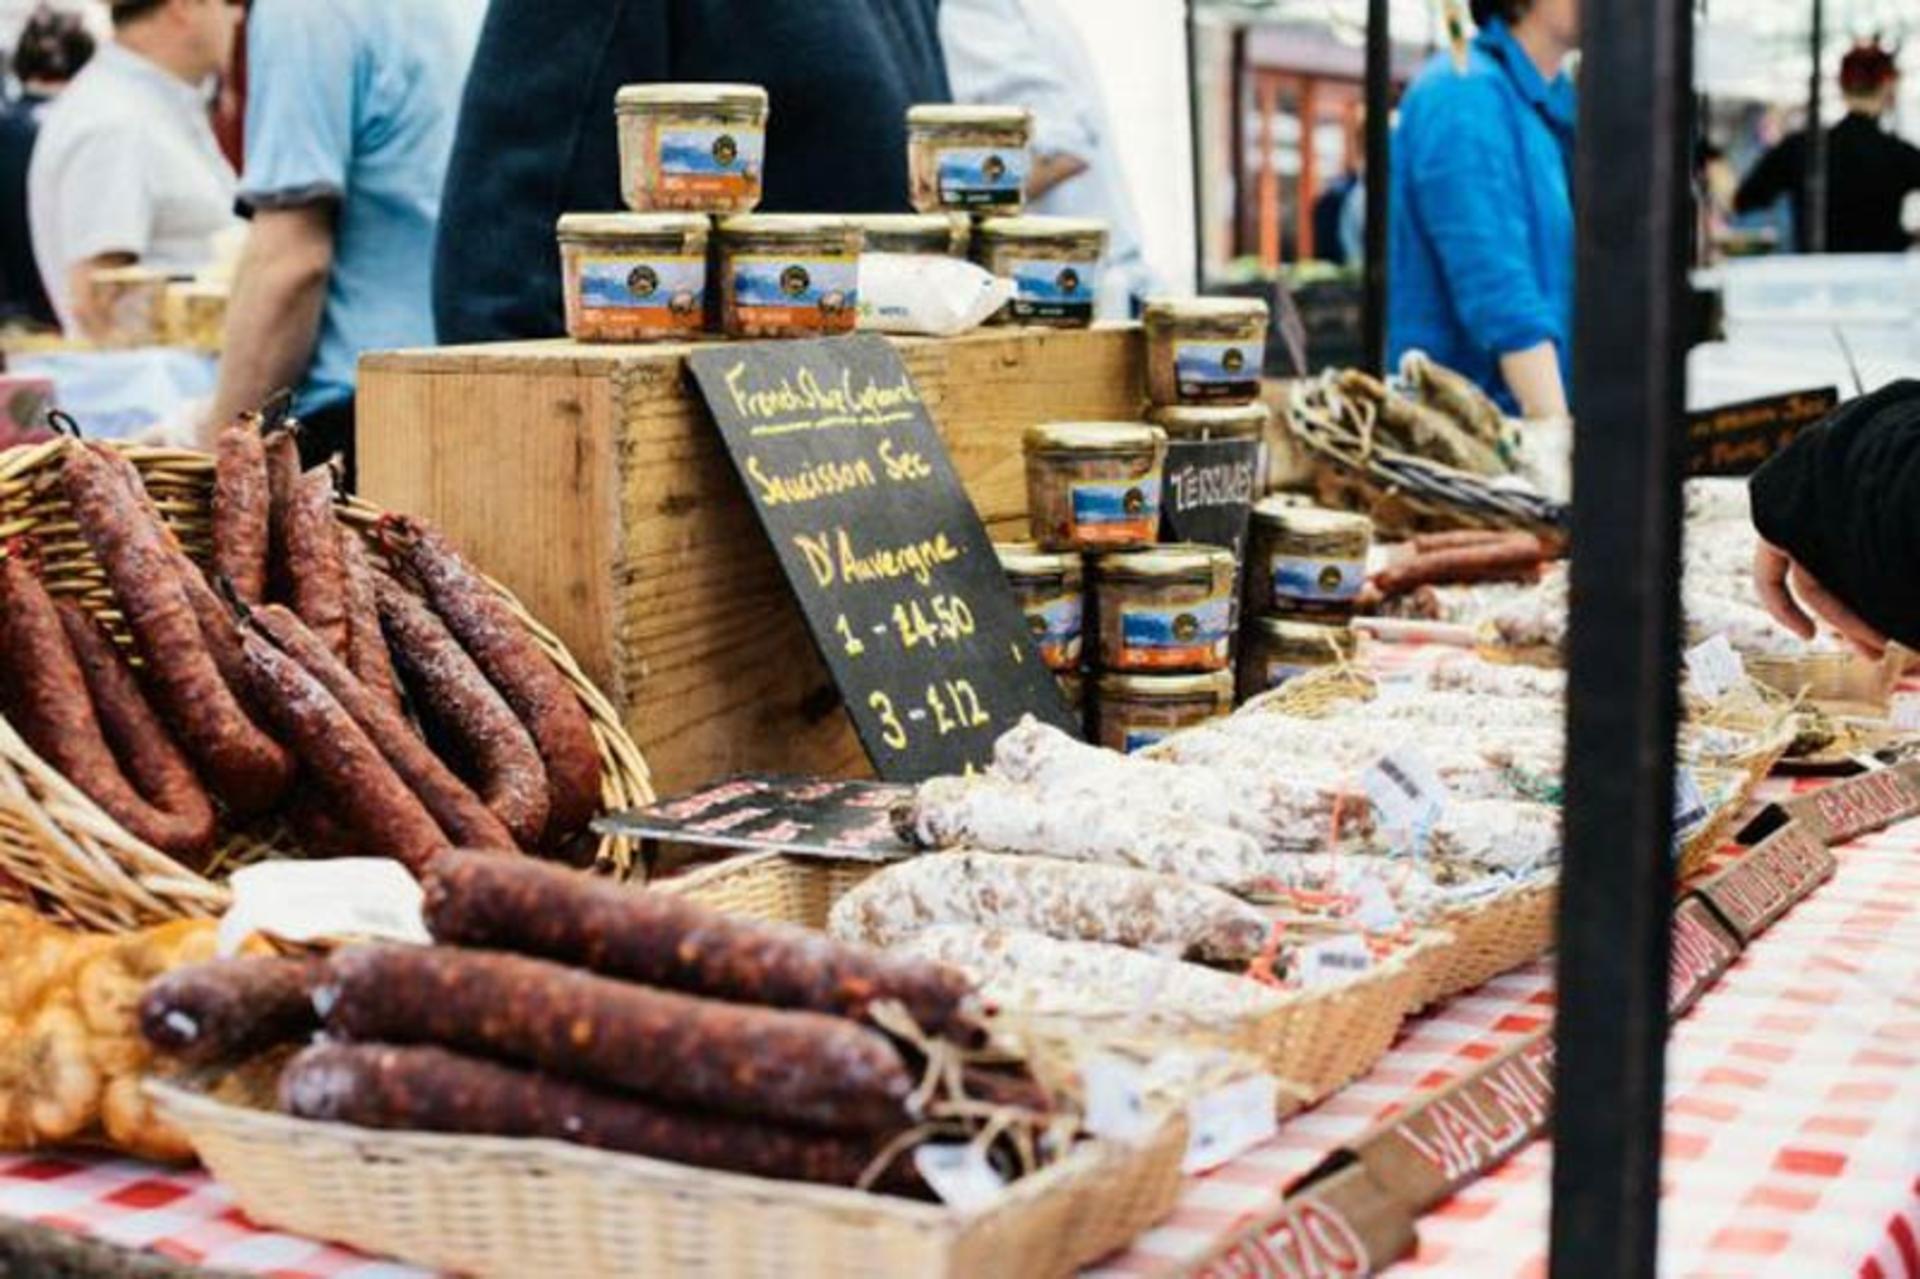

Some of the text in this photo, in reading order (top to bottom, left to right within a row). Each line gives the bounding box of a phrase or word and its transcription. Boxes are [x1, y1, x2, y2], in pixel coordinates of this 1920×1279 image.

[747, 437, 932, 507] Saucisson Sec
[835, 613, 865, 656] 1
[868, 690, 907, 749] 3
[926, 678, 991, 735] £12
